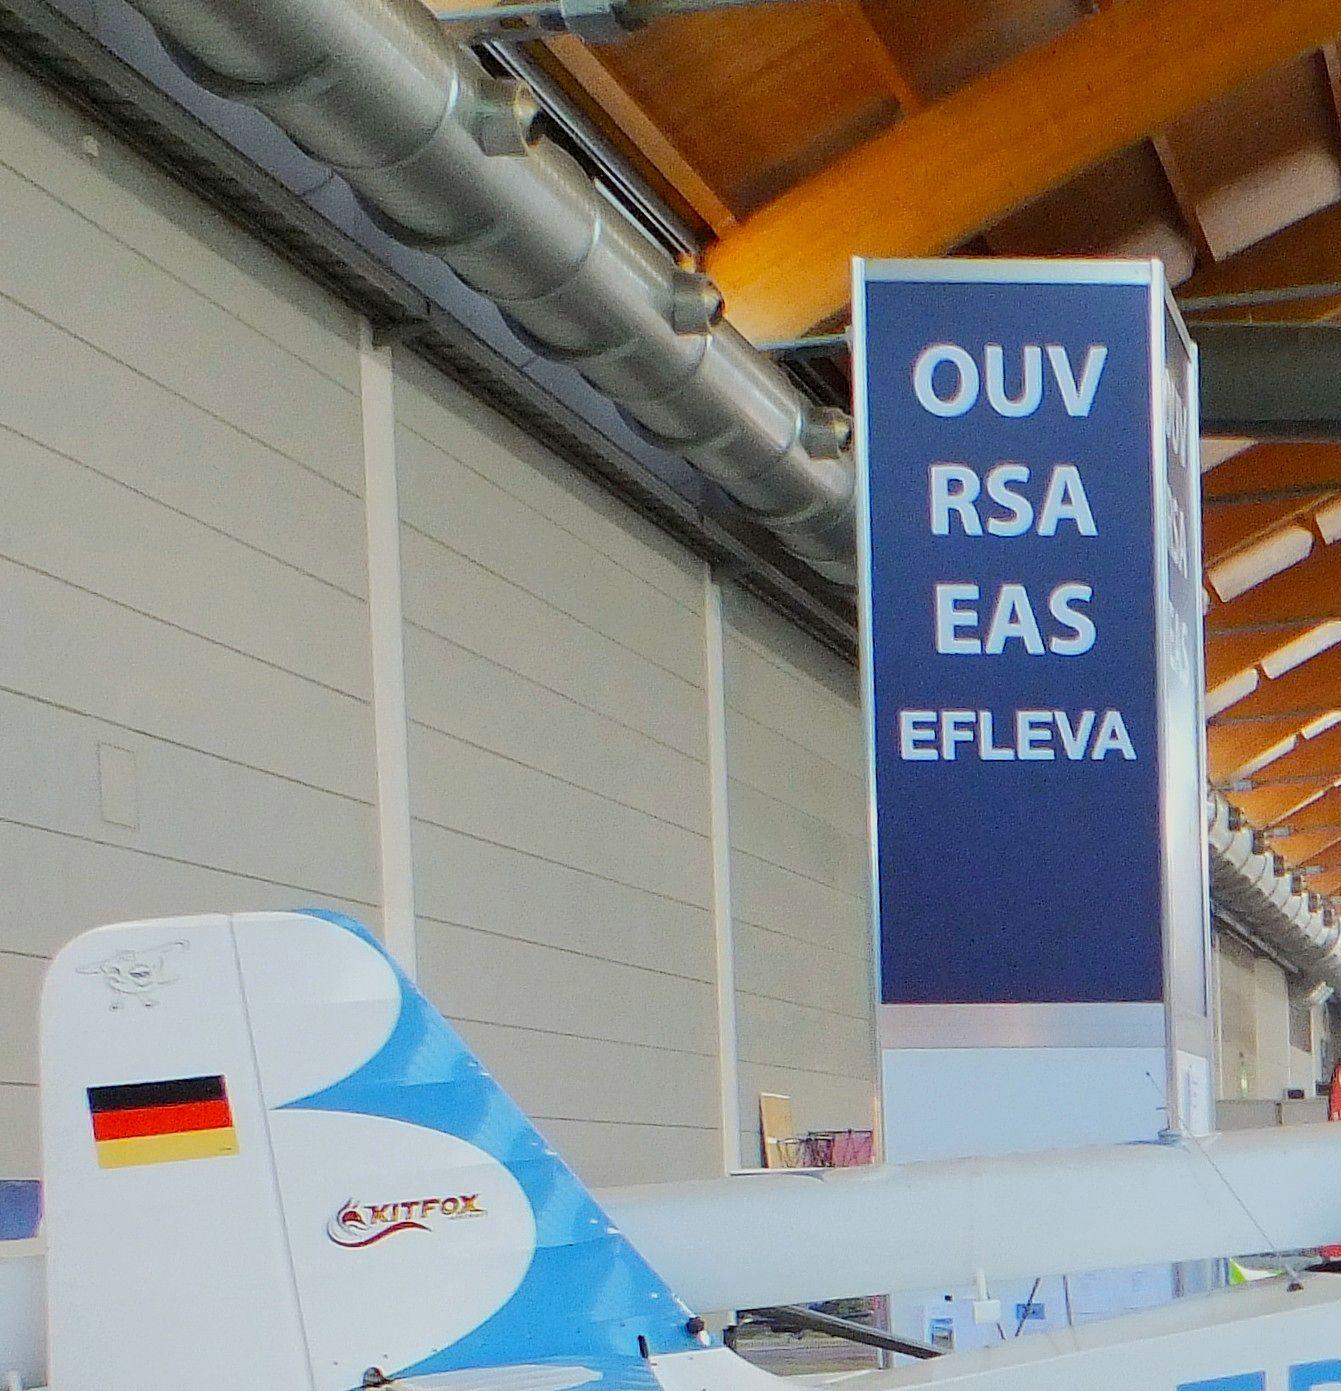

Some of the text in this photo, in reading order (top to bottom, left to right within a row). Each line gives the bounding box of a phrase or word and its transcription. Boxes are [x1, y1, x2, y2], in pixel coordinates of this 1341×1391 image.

[912, 344, 1109, 419] OUV
[928, 463, 1099, 539] RSA
[934, 583, 1097, 658] EAS
[899, 710, 1137, 763] EFLEVA
[364, 1193, 484, 1226] KITFOX
